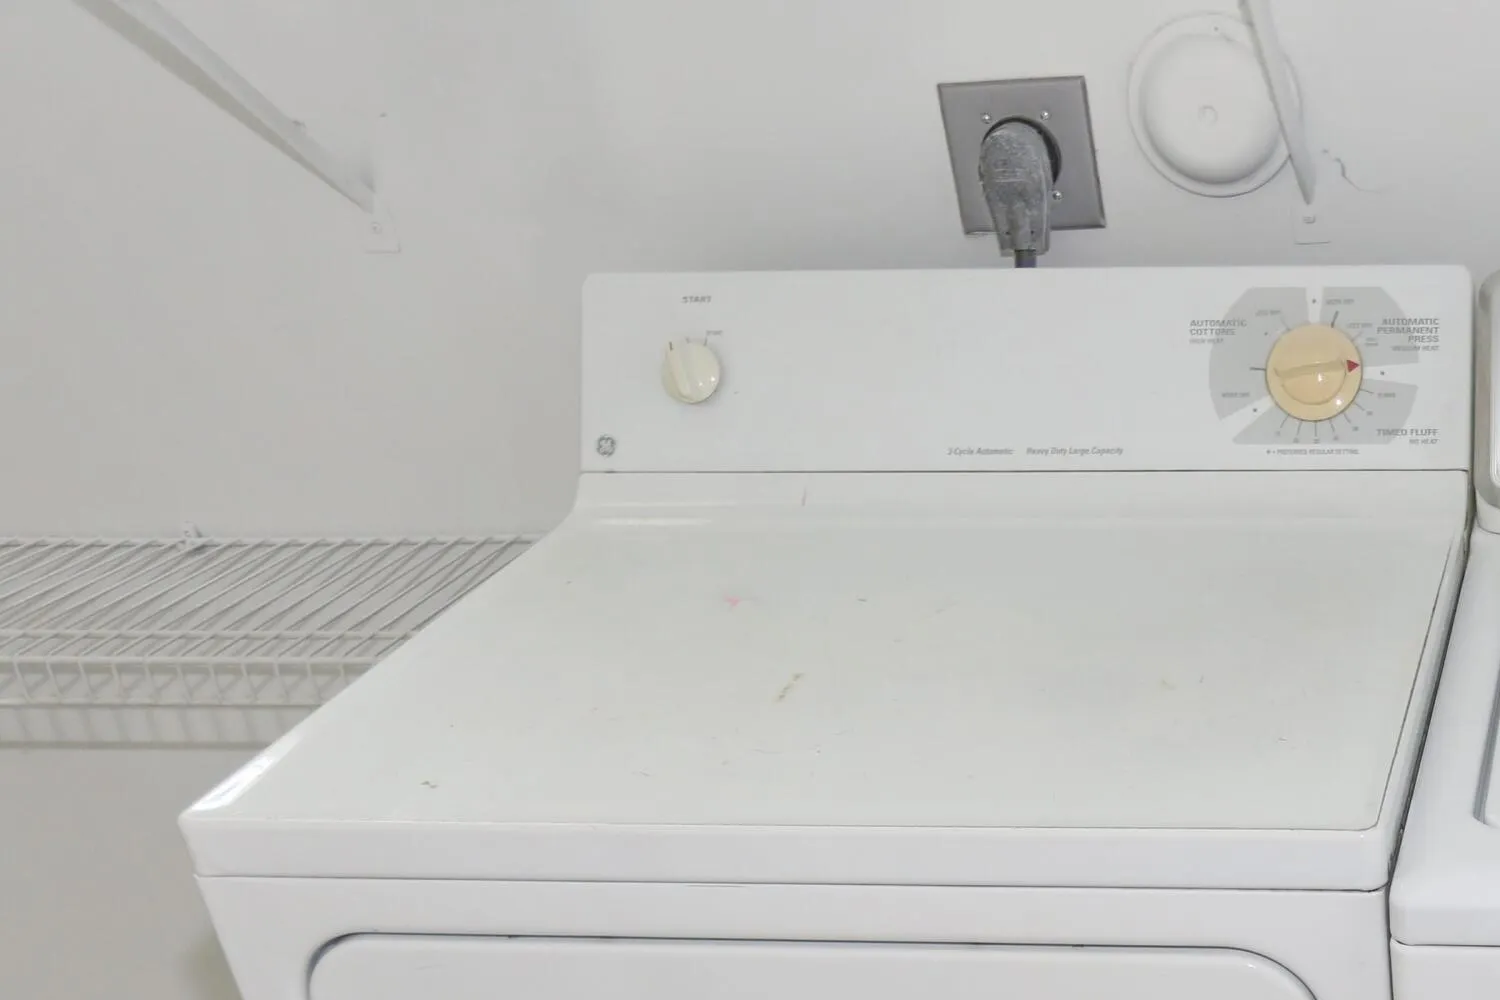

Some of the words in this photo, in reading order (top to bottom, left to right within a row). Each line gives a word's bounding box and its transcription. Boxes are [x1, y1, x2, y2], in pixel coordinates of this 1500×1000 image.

[681, 295, 712, 303] START
[1190, 319, 1248, 327] AUTOMATIC
[1381, 318, 1440, 326] AUTOMATIC
[1377, 326, 1440, 335] PERMANENT
[1408, 335, 1440, 343] PRESS
[1376, 428, 1408, 436] TIMED
[1410, 428, 1440, 436] FLUFF
[1026, 446, 1049, 456] Heavy
[1050, 446, 1067, 456] Duty
[1068, 446, 1090, 456] Large
[1091, 446, 1124, 456] Capacity
